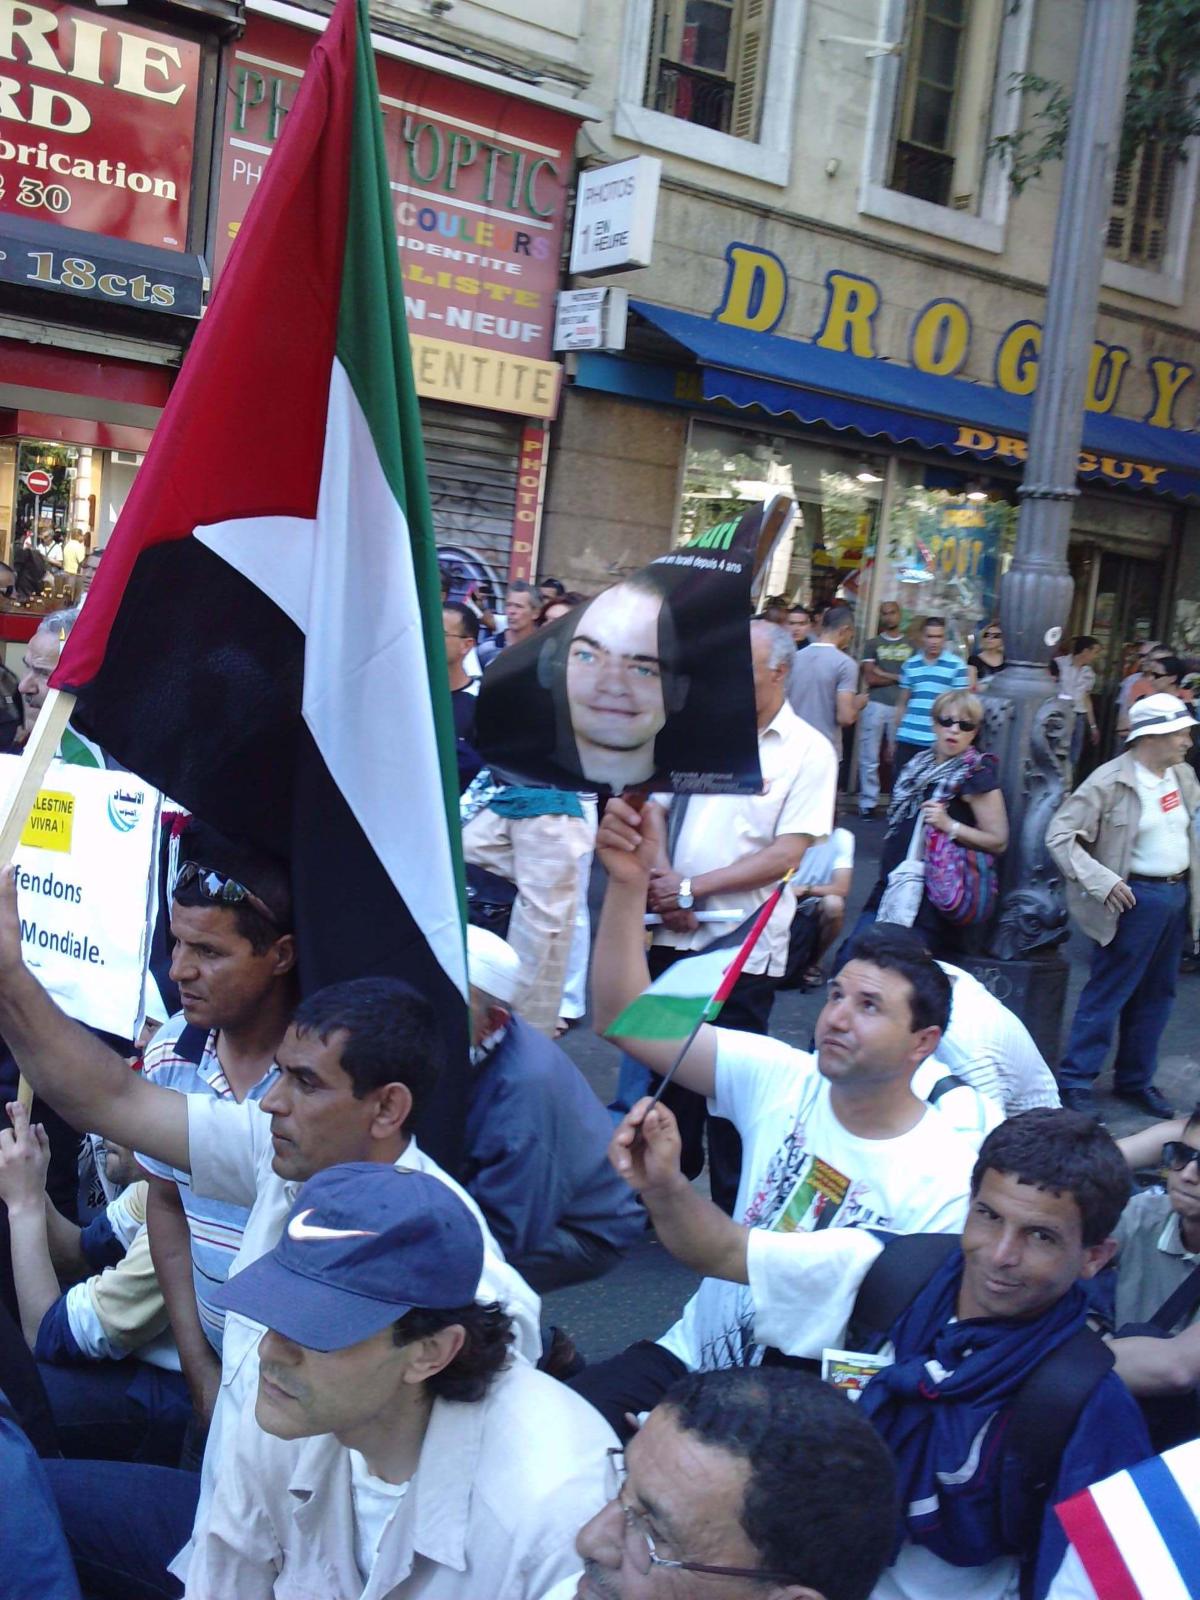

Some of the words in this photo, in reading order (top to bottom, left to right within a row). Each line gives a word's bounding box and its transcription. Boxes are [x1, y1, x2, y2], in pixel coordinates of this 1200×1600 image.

[0, 0, 187, 105] RIE
[16, 176, 72, 213] 30
[397, 201, 550, 261] COULEURS
[397, 235, 523, 276] IDENTITE
[26, 251, 176, 307] 18cts
[401, 263, 541, 309] LISTE
[717, 240, 1195, 430] DROGUY
[411, 344, 553, 404] ENTITE
[517, 440, 542, 522] PHOTO
[953, 426, 1167, 485] DRGUY
[726, 562, 742, 573] ans
[30, 816, 59, 833] VIVRA
[14, 864, 83, 904] fendons
[21, 918, 106, 966] Mondiale.
